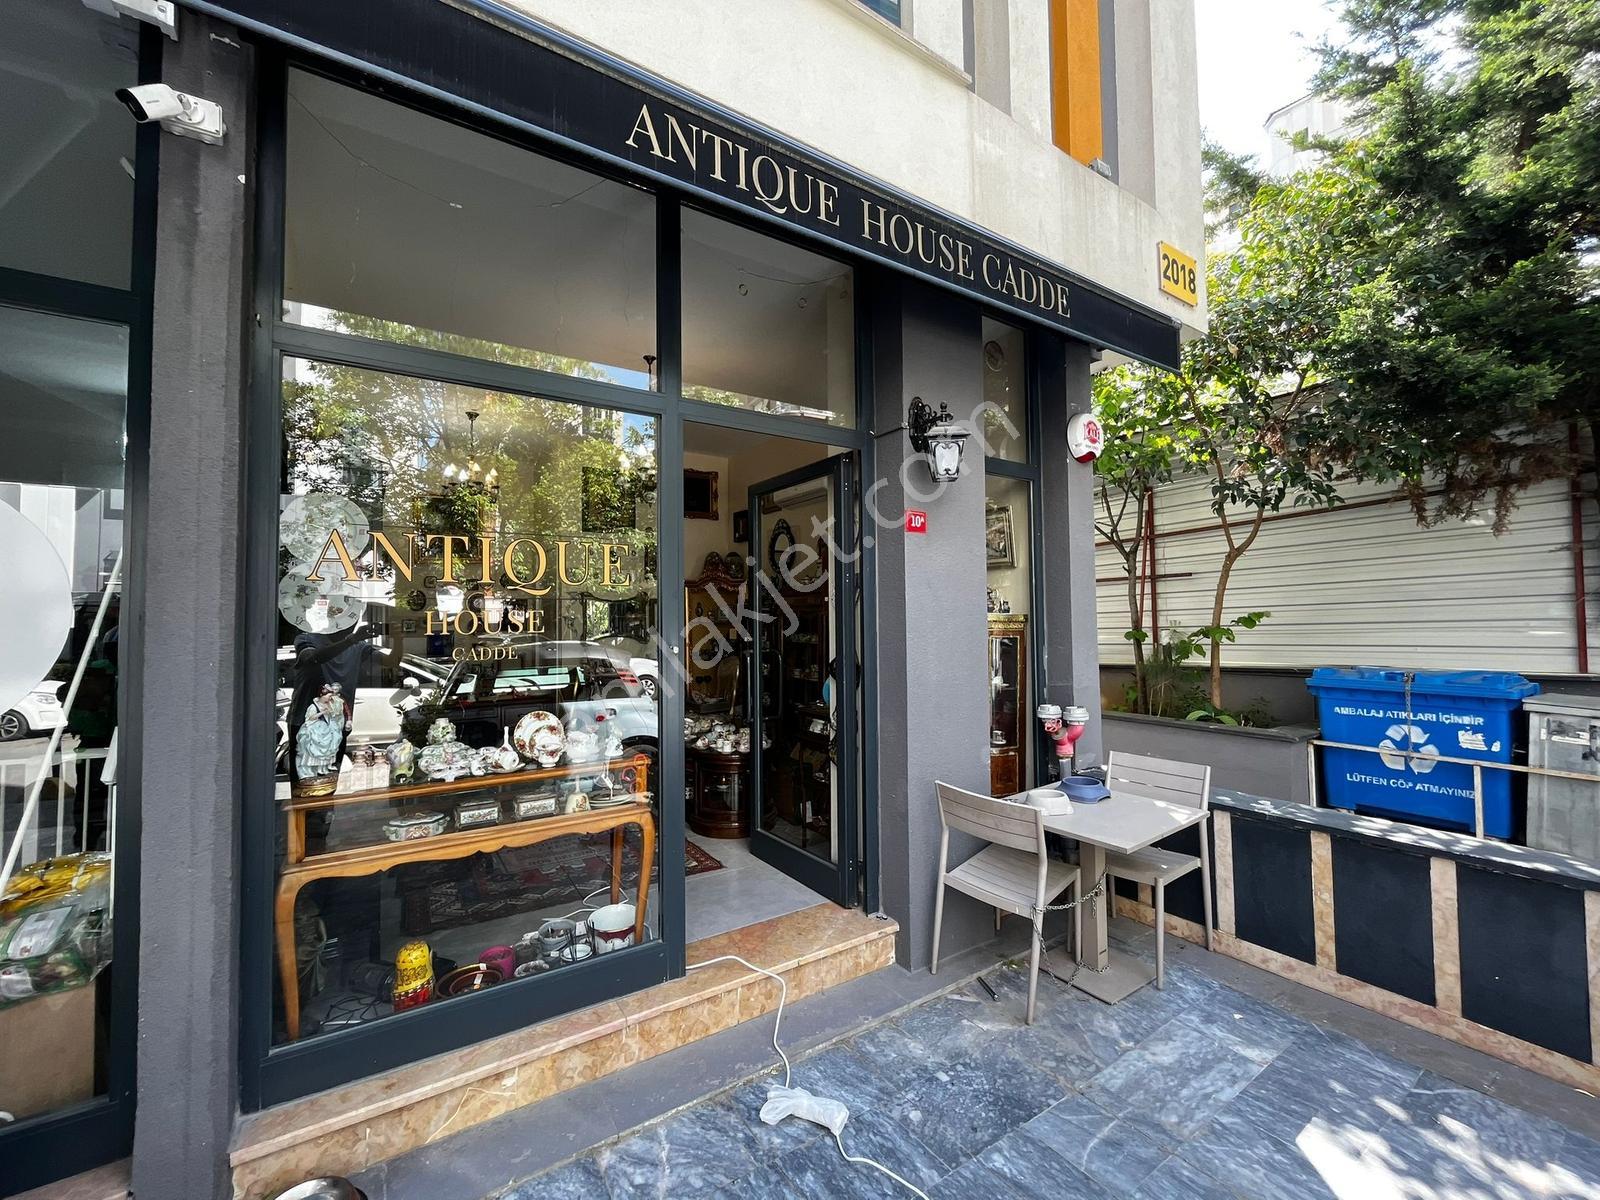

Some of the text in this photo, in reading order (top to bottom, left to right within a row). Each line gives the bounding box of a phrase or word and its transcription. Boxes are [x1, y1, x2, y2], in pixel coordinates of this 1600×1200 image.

[625, 103, 1071, 319] ANTIQUE HOUSE CADDE
[1162, 253, 1196, 294] 2018
[305, 528, 632, 596] ANTIQUE
[424, 610, 545, 635] HOUSE
[452, 646, 518, 660] CADDE
[1334, 706, 1383, 717] AMBALAJ
[1385, 711, 1437, 723] ATIKLARI
[1415, 783, 1475, 799] ATMAYINIZ
